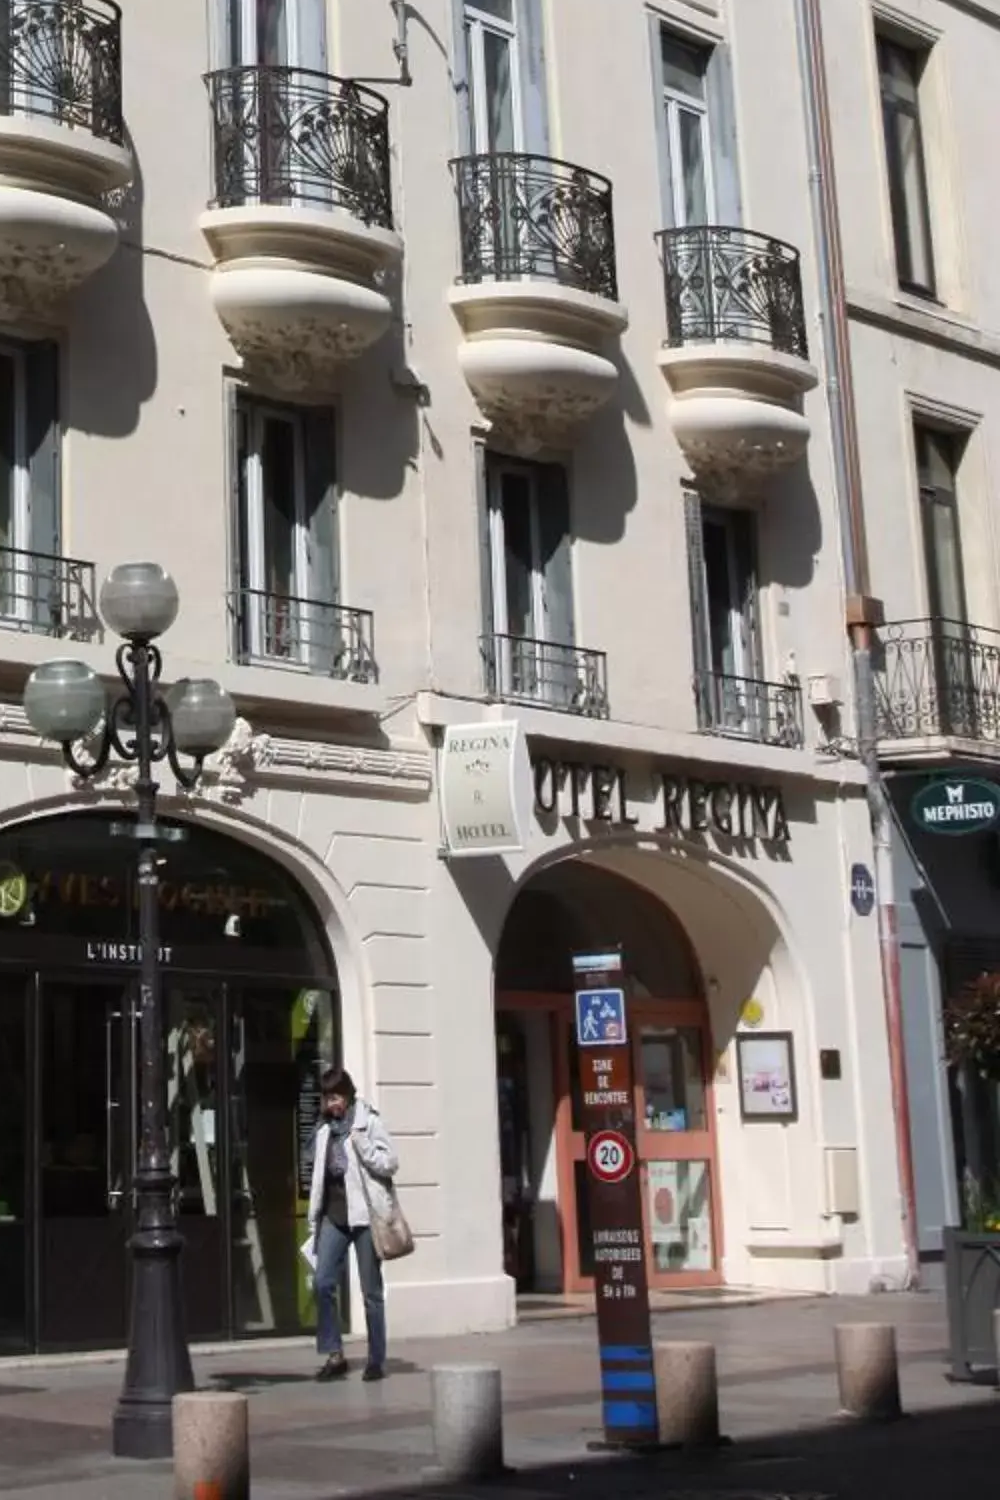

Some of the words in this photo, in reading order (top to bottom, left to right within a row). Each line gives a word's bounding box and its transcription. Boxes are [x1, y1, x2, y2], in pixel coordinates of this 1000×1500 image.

[449, 734, 511, 753] REGINA
[532, 756, 640, 825] OTEL
[661, 772, 791, 841] REGINA
[923, 802, 996, 822] MEPHISTO
[456, 822, 512, 841] HOTEL
[87, 942, 172, 962] L'INSTIT
[592, 1058, 614, 1073] ZONE
[597, 1075, 609, 1089] DE
[584, 1091, 629, 1105] RENCONTRE
[600, 1146, 619, 1166] 20
[593, 1229, 640, 1244] LIVRAISONS
